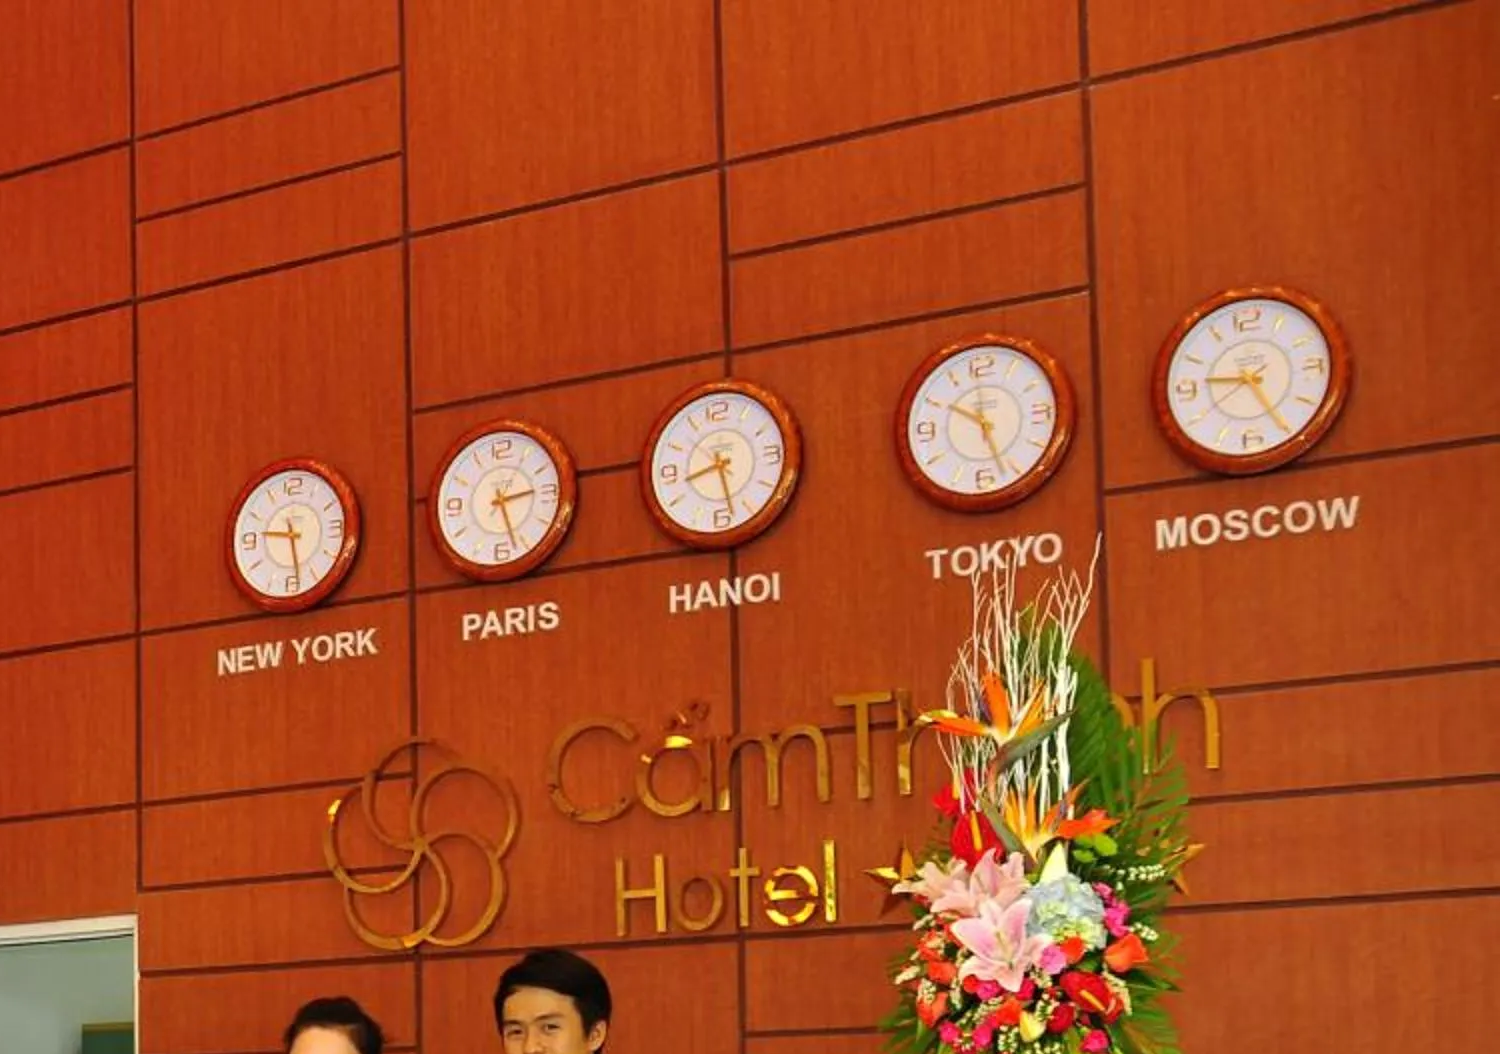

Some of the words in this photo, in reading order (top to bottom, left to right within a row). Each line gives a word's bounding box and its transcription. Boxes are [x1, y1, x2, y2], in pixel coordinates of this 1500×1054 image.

[1233, 305, 1261, 333] 12
[969, 355, 996, 379] 12
[706, 401, 729, 422] 12
[917, 421, 935, 443] 9
[492, 440, 512, 460] 12
[764, 445, 780, 464] 3
[661, 464, 677, 484] 9
[284, 477, 304, 496] 12
[447, 497, 463, 517] 9
[713, 507, 732, 529] 6
[327, 519, 343, 539] 3
[1155, 496, 1359, 550] MOSCOW
[243, 532, 257, 551] 9
[493, 542, 511, 562] 6
[925, 532, 1063, 579] TOKYO
[670, 573, 780, 613] HANOI
[463, 602, 559, 641] PARIS
[218, 641, 283, 675] NEW
[291, 628, 376, 663] YORK
[614, 838, 838, 938] Hotel
